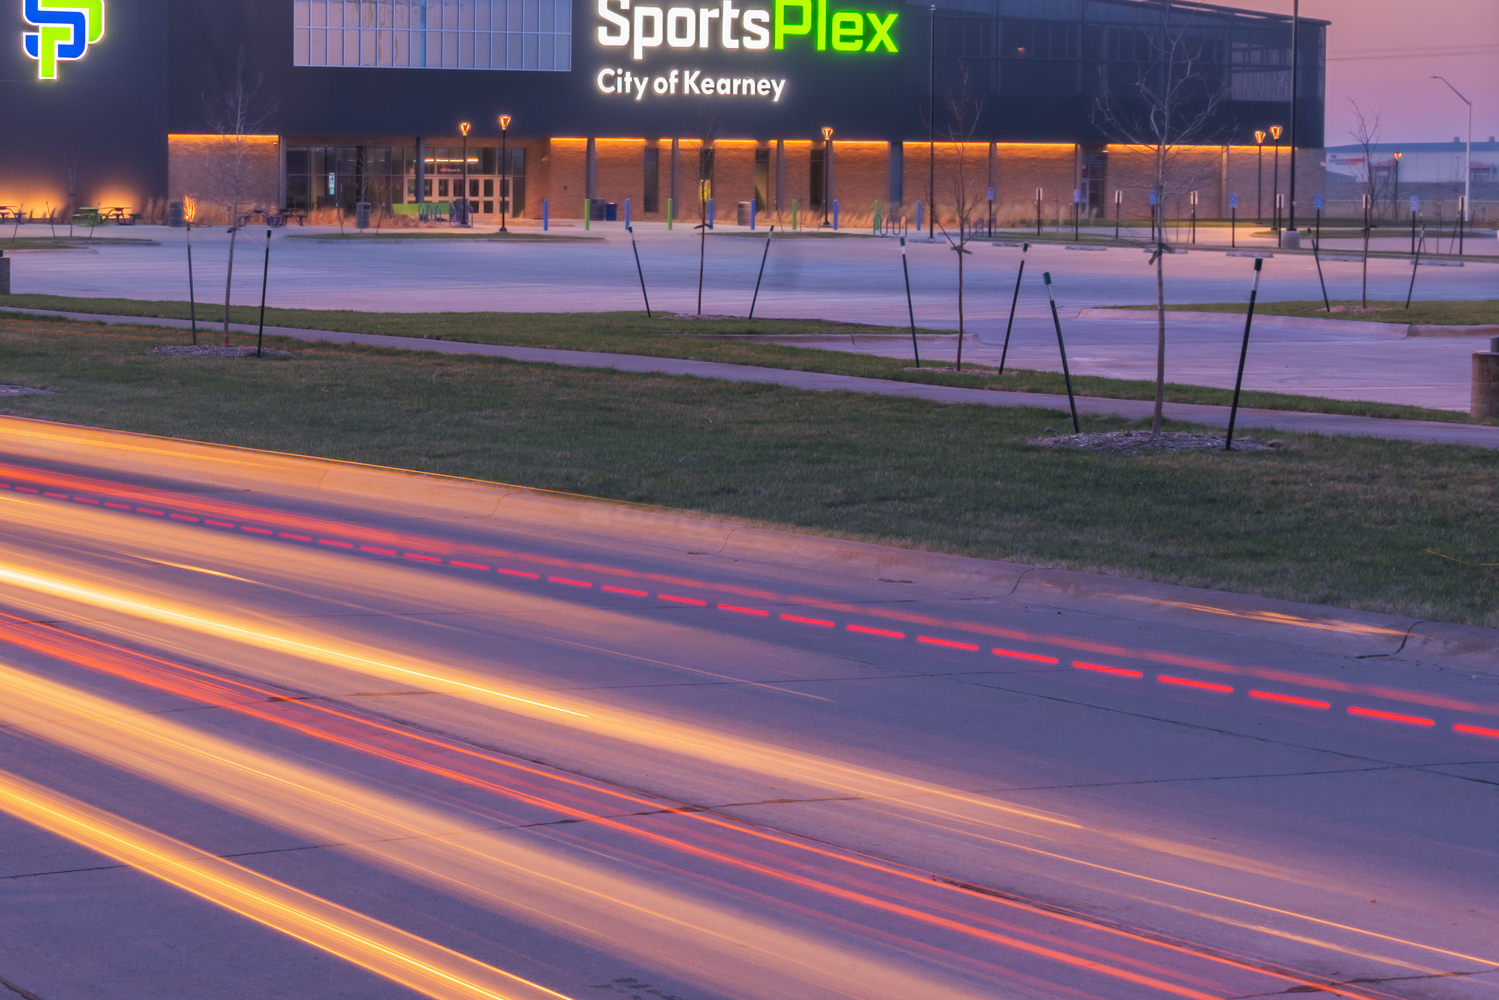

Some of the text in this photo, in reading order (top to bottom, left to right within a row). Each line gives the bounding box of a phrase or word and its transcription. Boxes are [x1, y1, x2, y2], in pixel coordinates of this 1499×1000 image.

[597, 68, 786, 102] City of Kearney
